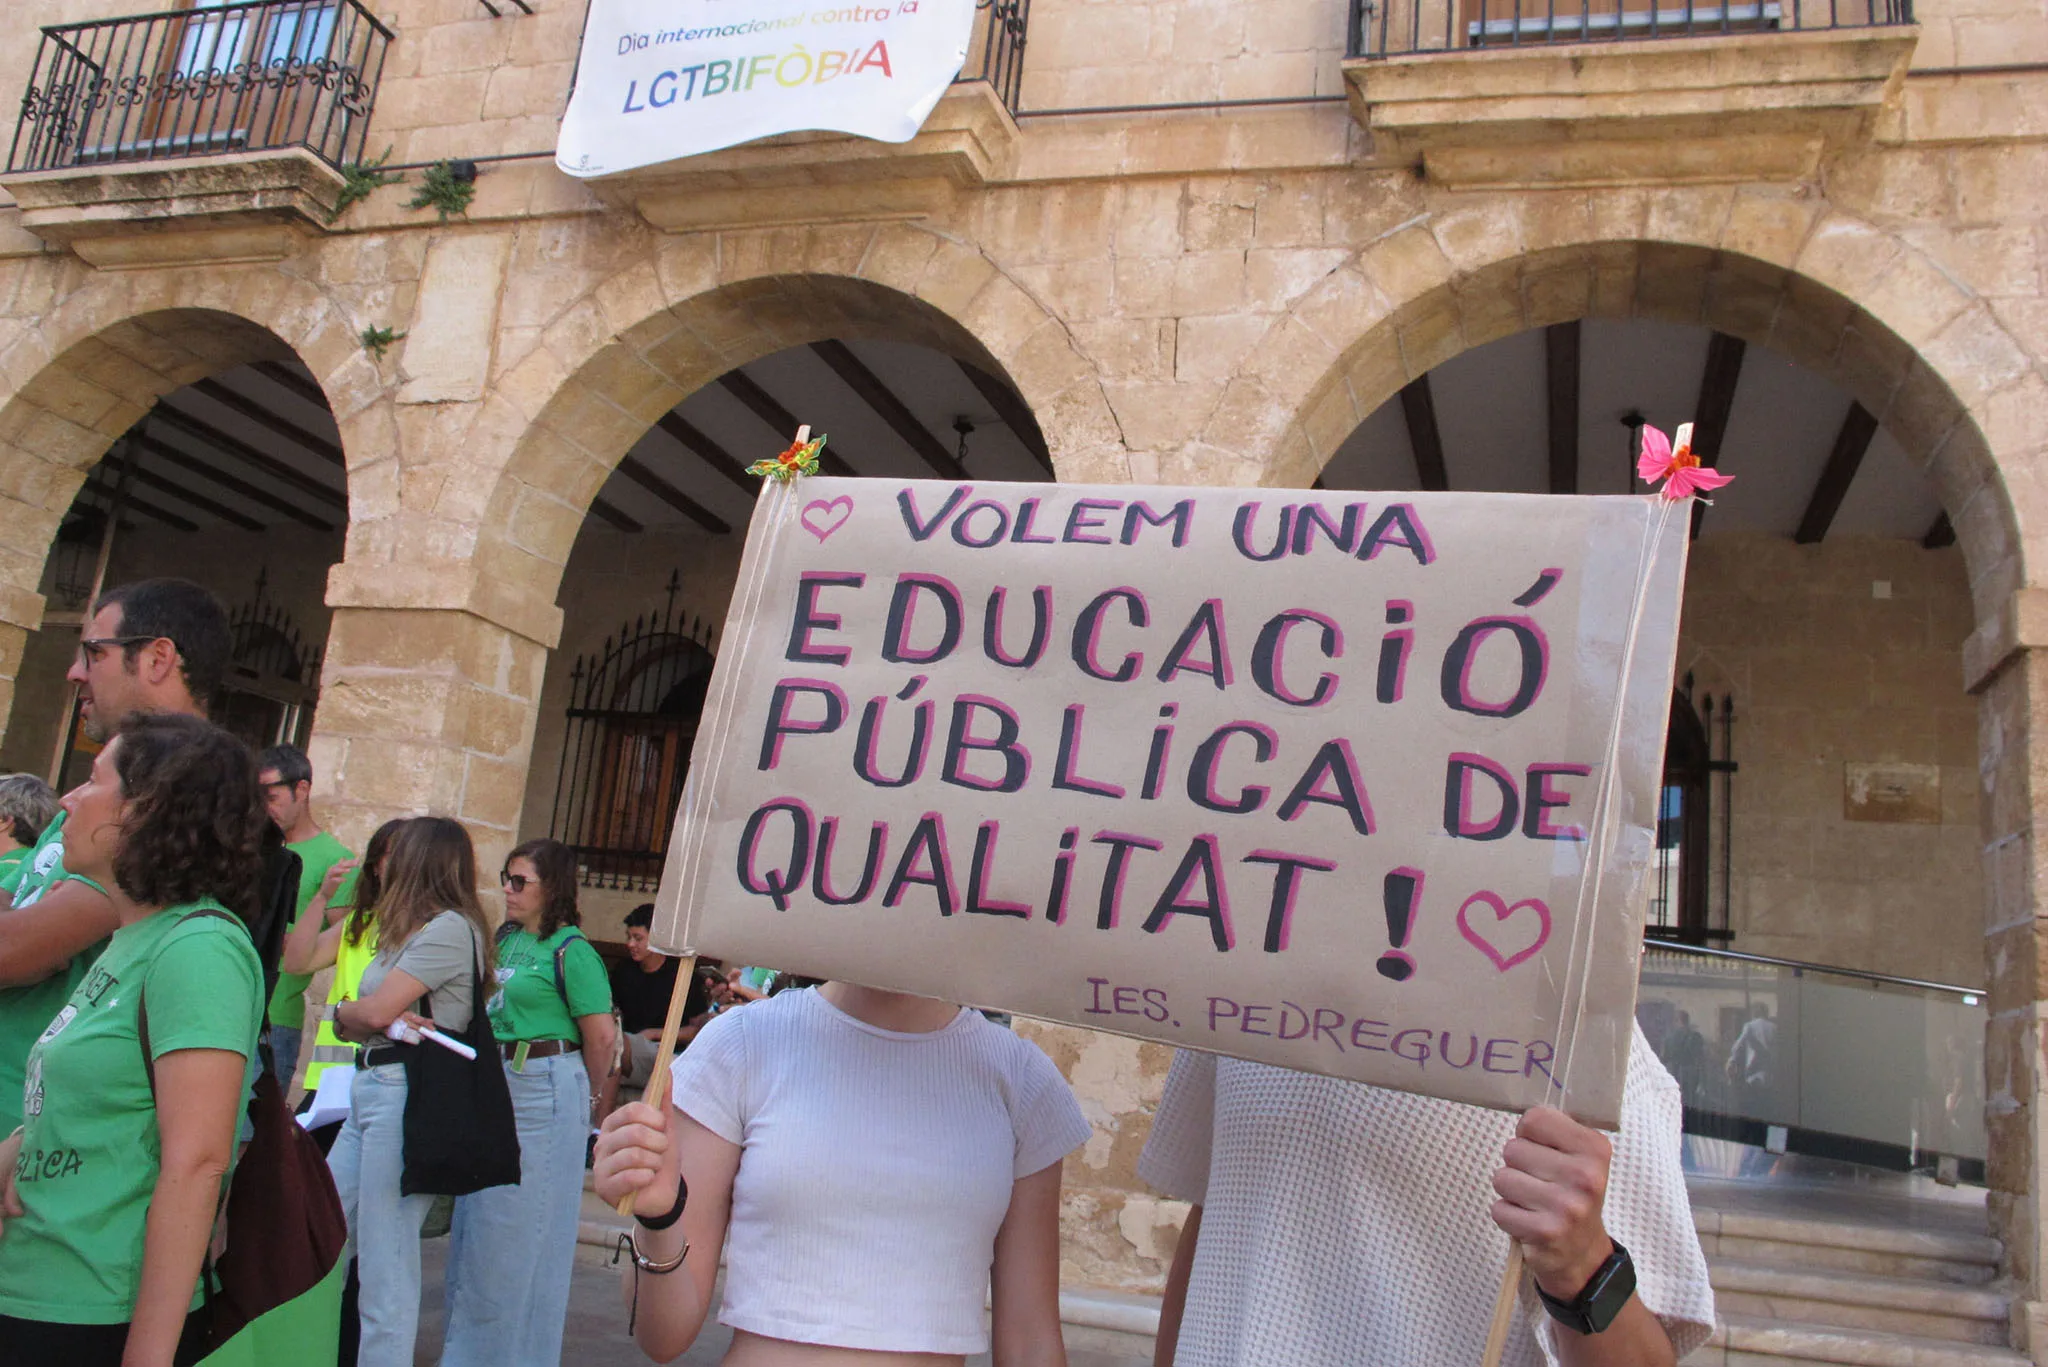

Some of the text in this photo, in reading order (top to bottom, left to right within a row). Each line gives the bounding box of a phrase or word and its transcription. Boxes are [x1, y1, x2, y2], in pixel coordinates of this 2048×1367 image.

[617, 33, 650, 56] Dia
[655, 11, 805, 45] internacional
[810, 5, 892, 25] contra
[622, 39, 893, 115] LGTBIFÒBIA
[896, 485, 1437, 565] VOLEM UNA
[1443, 751, 1593, 842] DE
[1206, 995, 1563, 1090] PEDREGUER
